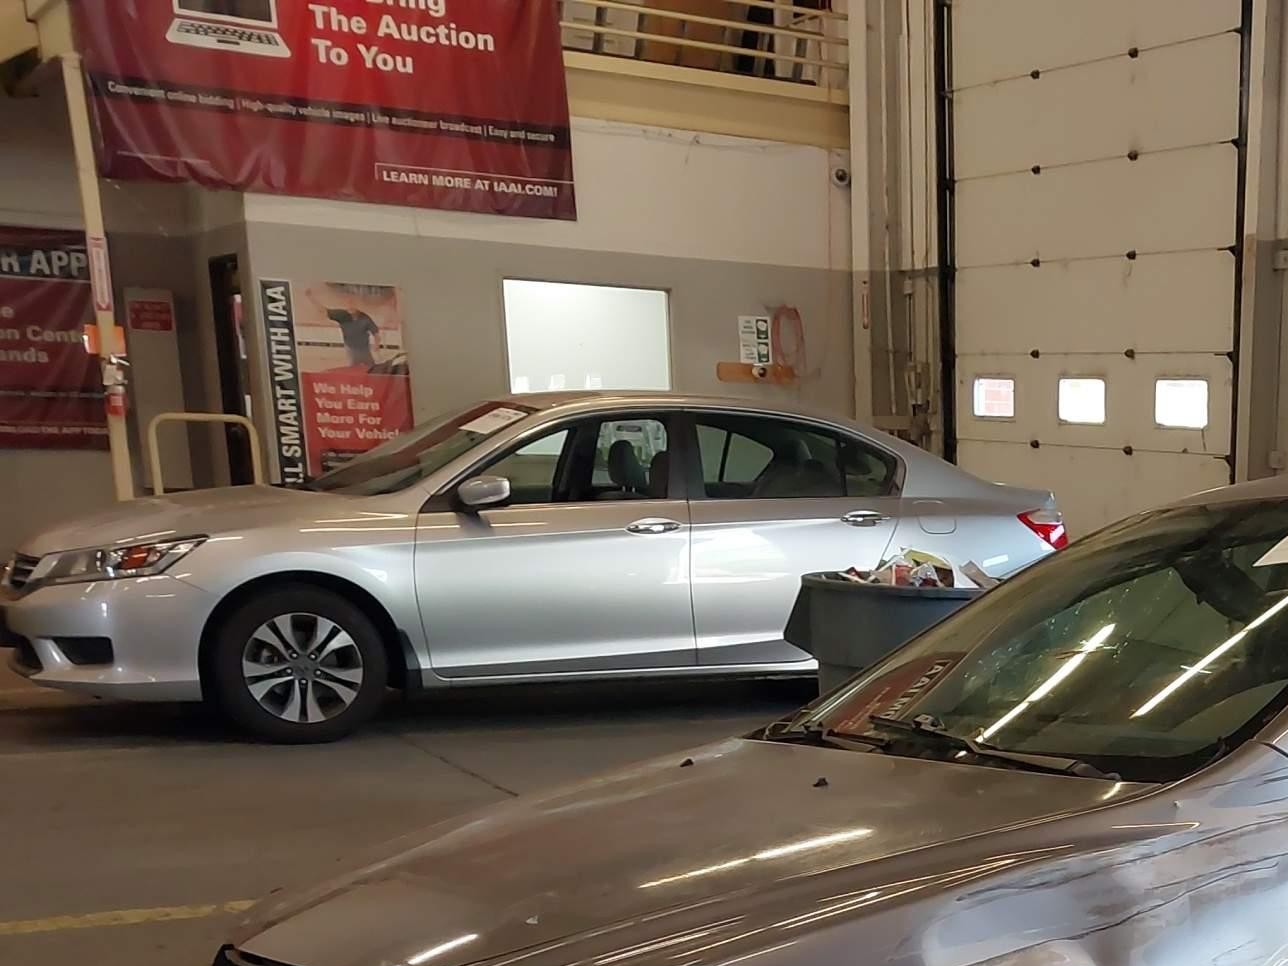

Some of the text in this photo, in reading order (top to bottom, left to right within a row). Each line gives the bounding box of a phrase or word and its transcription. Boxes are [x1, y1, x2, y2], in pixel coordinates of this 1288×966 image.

[308, 3, 367, 35] The
[377, 14, 495, 52] Auction
[311, 38, 414, 74] To You
[383, 170, 558, 198] LEARN MORE AT IAAI.COM!
[30, 249, 87, 277] APP
[266, 285, 289, 321] IAA
[269, 328, 294, 382] WITH
[313, 382, 373, 398] We Help
[315, 397, 380, 411] You Earn
[274, 387, 302, 458] SMART
[316, 412, 382, 425] More For
[318, 427, 352, 439] Your
